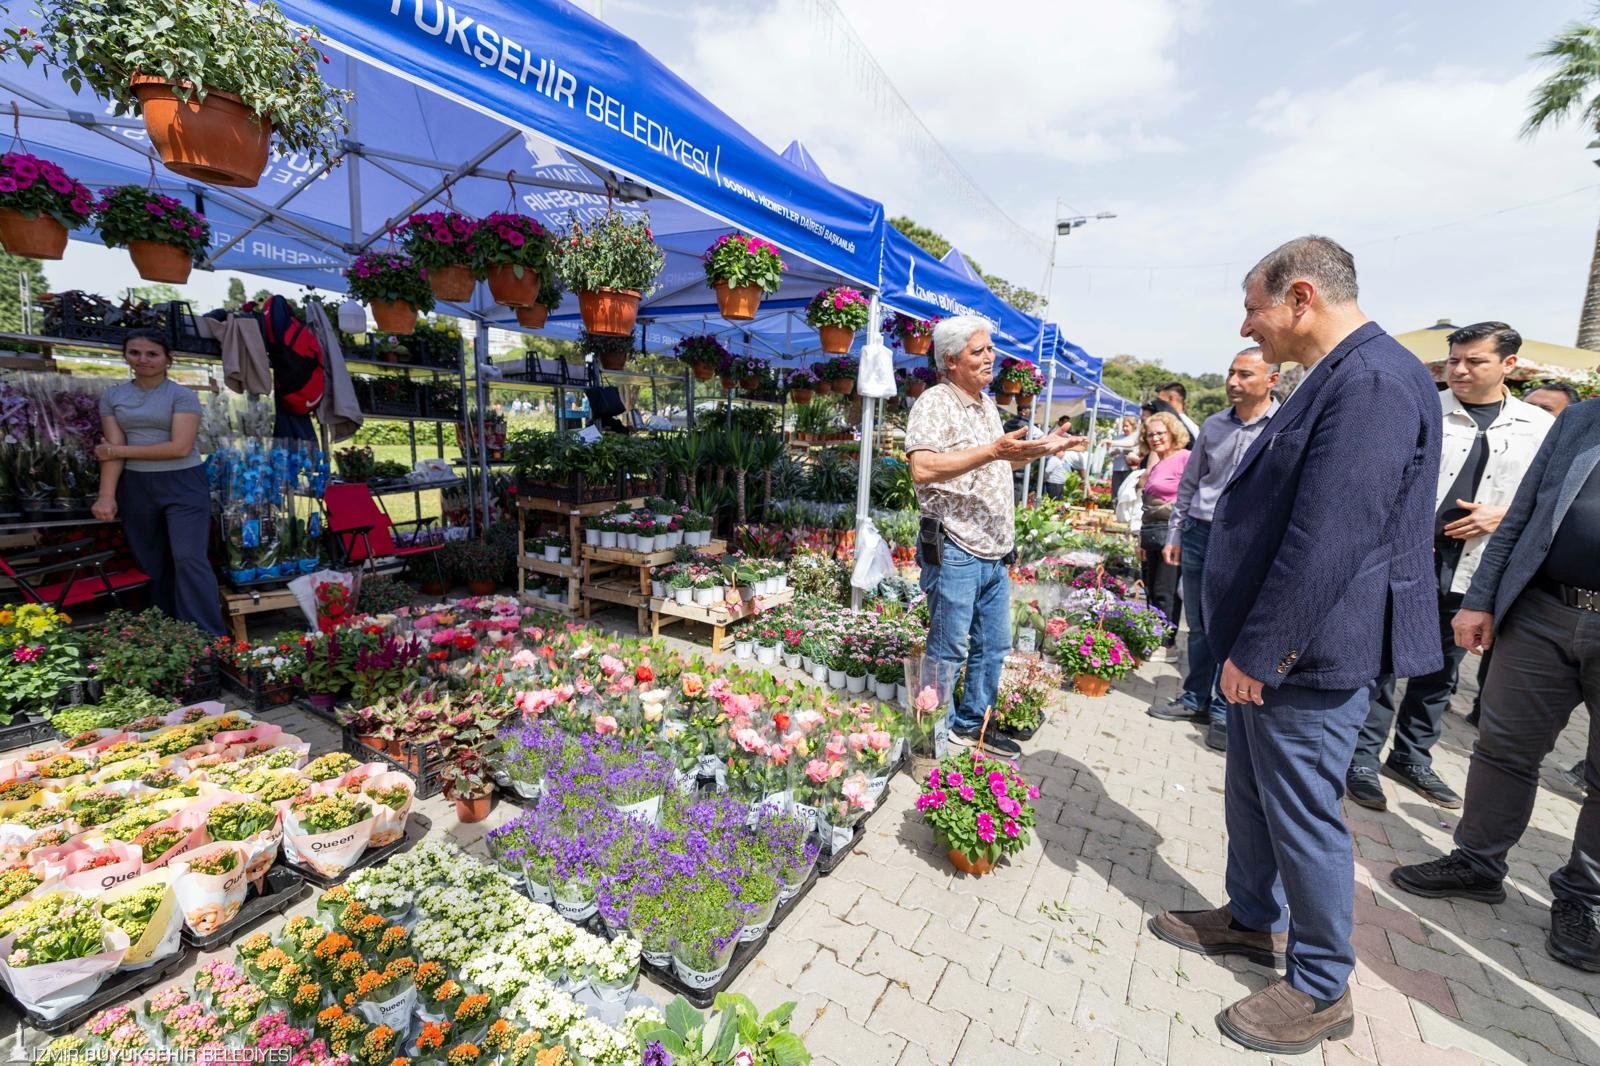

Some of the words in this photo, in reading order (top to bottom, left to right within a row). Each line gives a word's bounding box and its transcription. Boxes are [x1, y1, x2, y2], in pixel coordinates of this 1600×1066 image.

[585, 85, 710, 178] BELEDİYESİ
[723, 177, 758, 202] SOSYAL
[311, 833, 354, 853] Queen
[101, 869, 141, 890] Quee
[557, 903, 584, 913] Quee
[695, 971, 724, 983] Quee
[380, 998, 406, 1015] Queen
